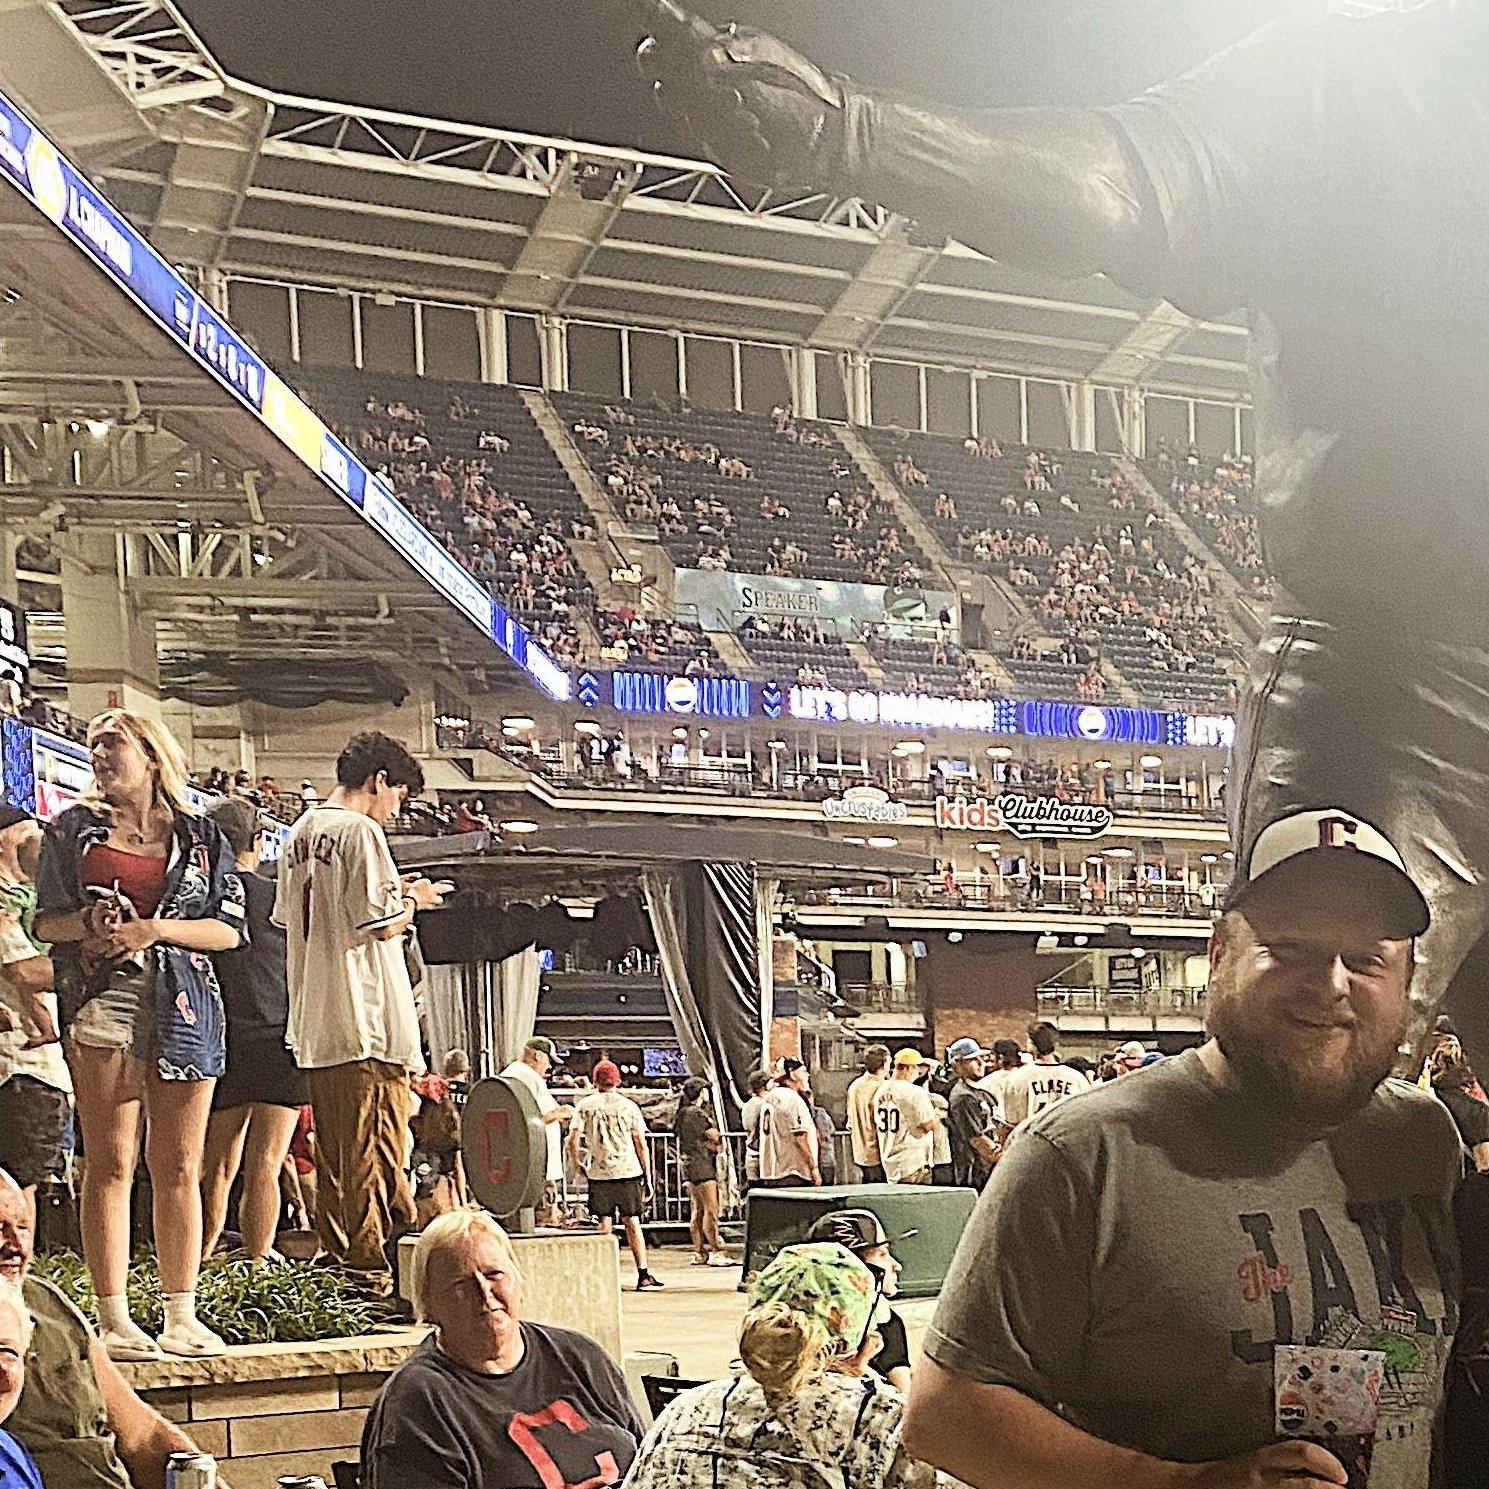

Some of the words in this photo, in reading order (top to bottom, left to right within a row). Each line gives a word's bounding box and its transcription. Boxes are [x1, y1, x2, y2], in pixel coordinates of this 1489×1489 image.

[742, 587, 819, 611] SPEAKER
[940, 800, 1000, 827] kids
[999, 797, 1107, 824] Clubhouse
[1031, 1079, 1073, 1095] CLASE
[877, 1107, 901, 1134] 30
[479, 1108, 512, 1185] C
